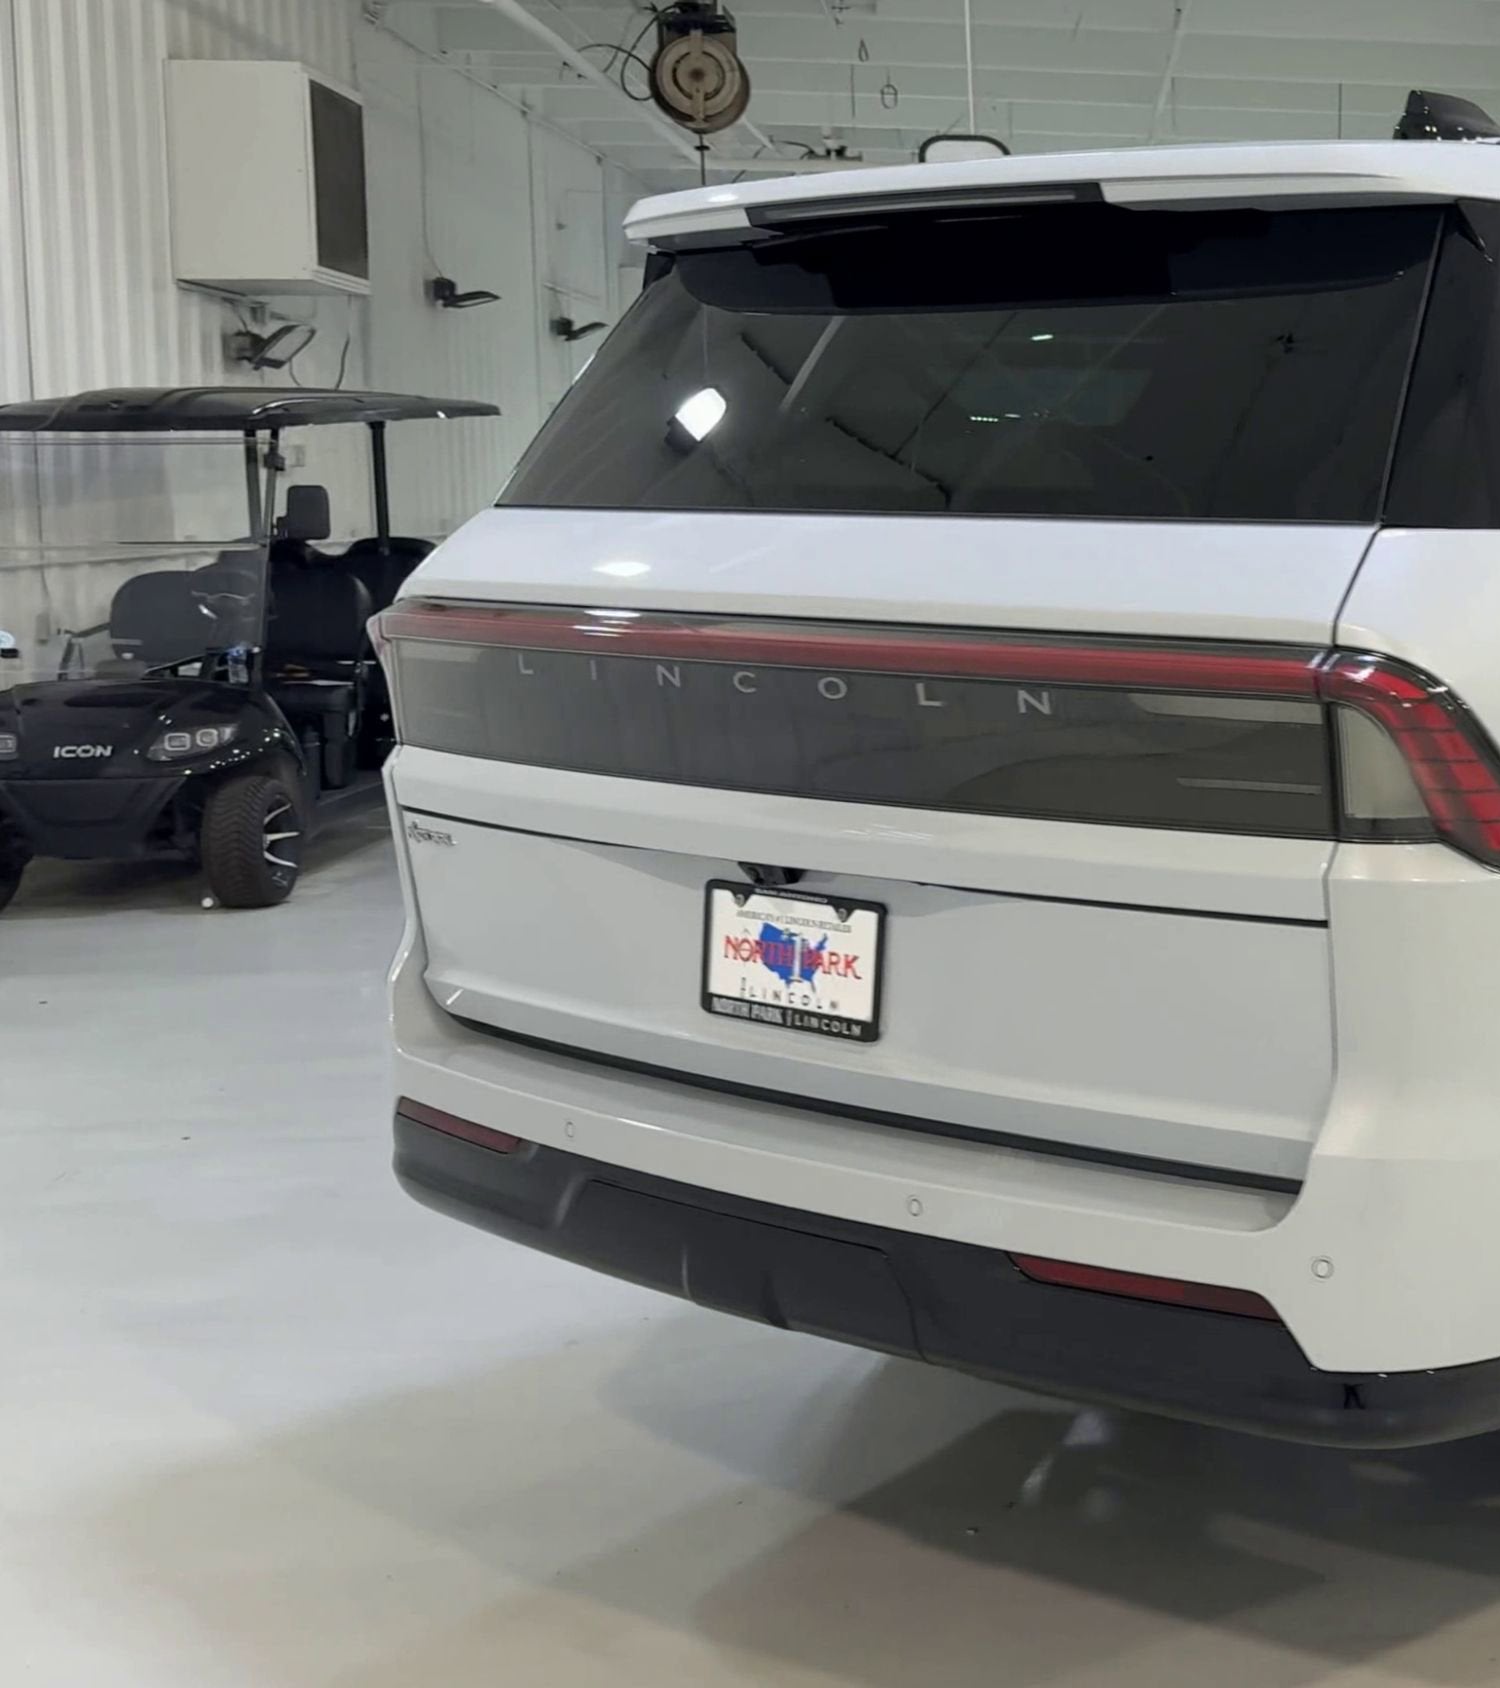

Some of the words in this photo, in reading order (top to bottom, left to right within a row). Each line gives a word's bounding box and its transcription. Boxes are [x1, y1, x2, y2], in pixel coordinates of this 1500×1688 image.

[517, 655, 1051, 714] LINCOLN
[53, 744, 113, 758] ICON
[724, 935, 794, 967] NORTH
[801, 947, 862, 980] PARK
[749, 987, 839, 1009] LINCOLN
[751, 1002, 784, 1024] PARK
[794, 1012, 862, 1037] LINCOLN
